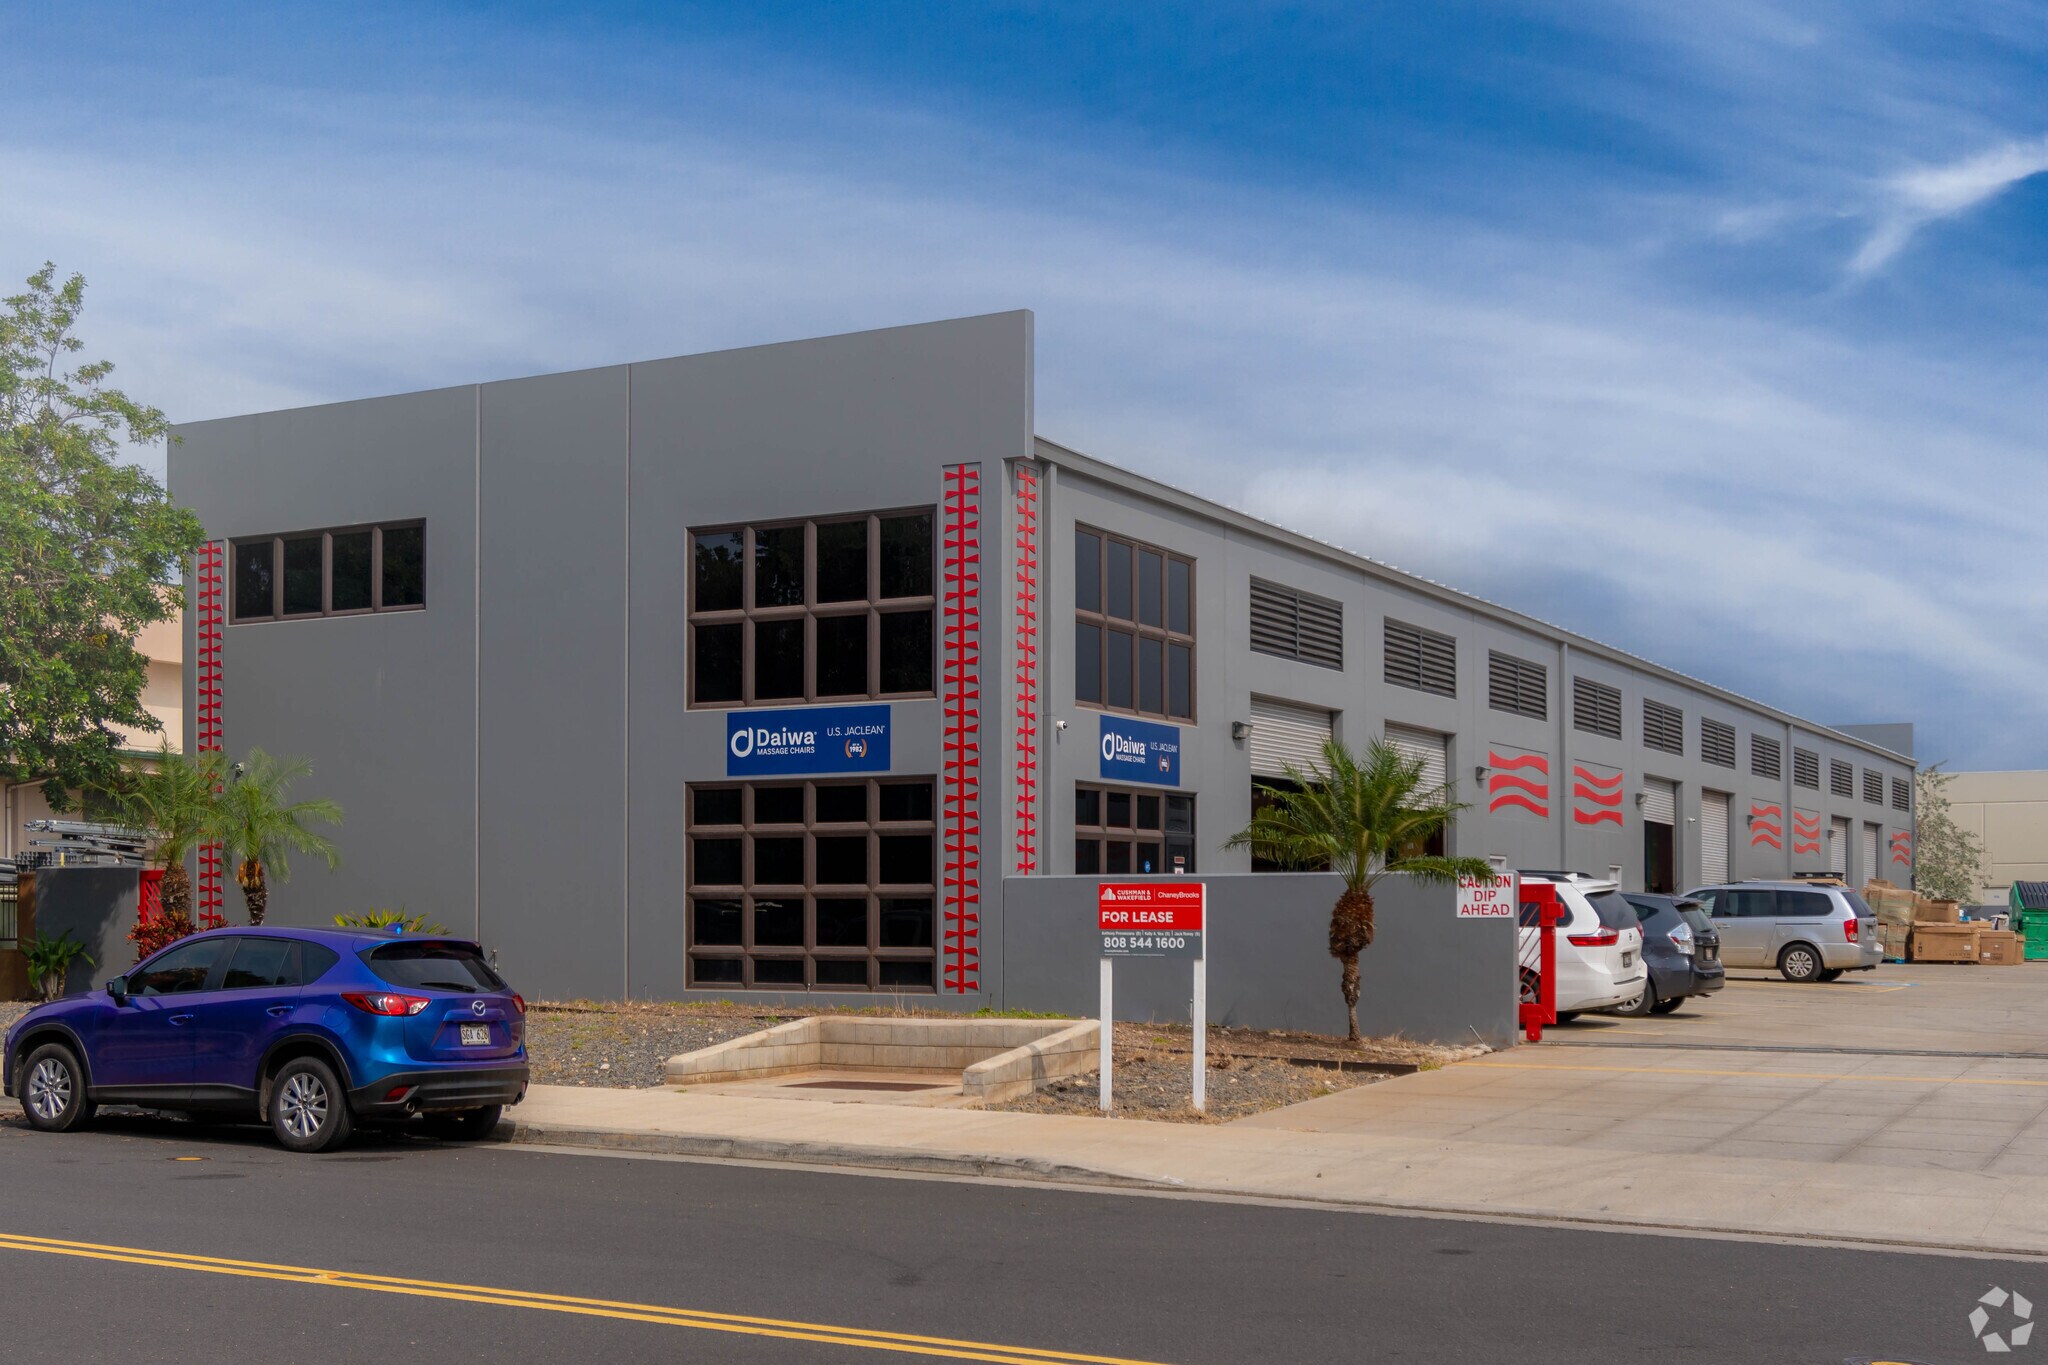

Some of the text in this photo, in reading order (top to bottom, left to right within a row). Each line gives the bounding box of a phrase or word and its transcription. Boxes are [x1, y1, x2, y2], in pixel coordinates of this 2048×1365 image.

[757, 727, 815, 747] Daiwa
[826, 725, 884, 737] U.S. JACLEAN
[757, 746, 815, 756] MASSAGE CHAIRS
[1115, 735, 1146, 756] Daiwa
[1157, 891, 1200, 900] ChaneyBrooks
[1473, 890, 1497, 902] DIP
[1460, 903, 1510, 916] AHEAD
[1102, 911, 1174, 923] FOR LEASE
[1103, 936, 1186, 949] 808 544 1600
